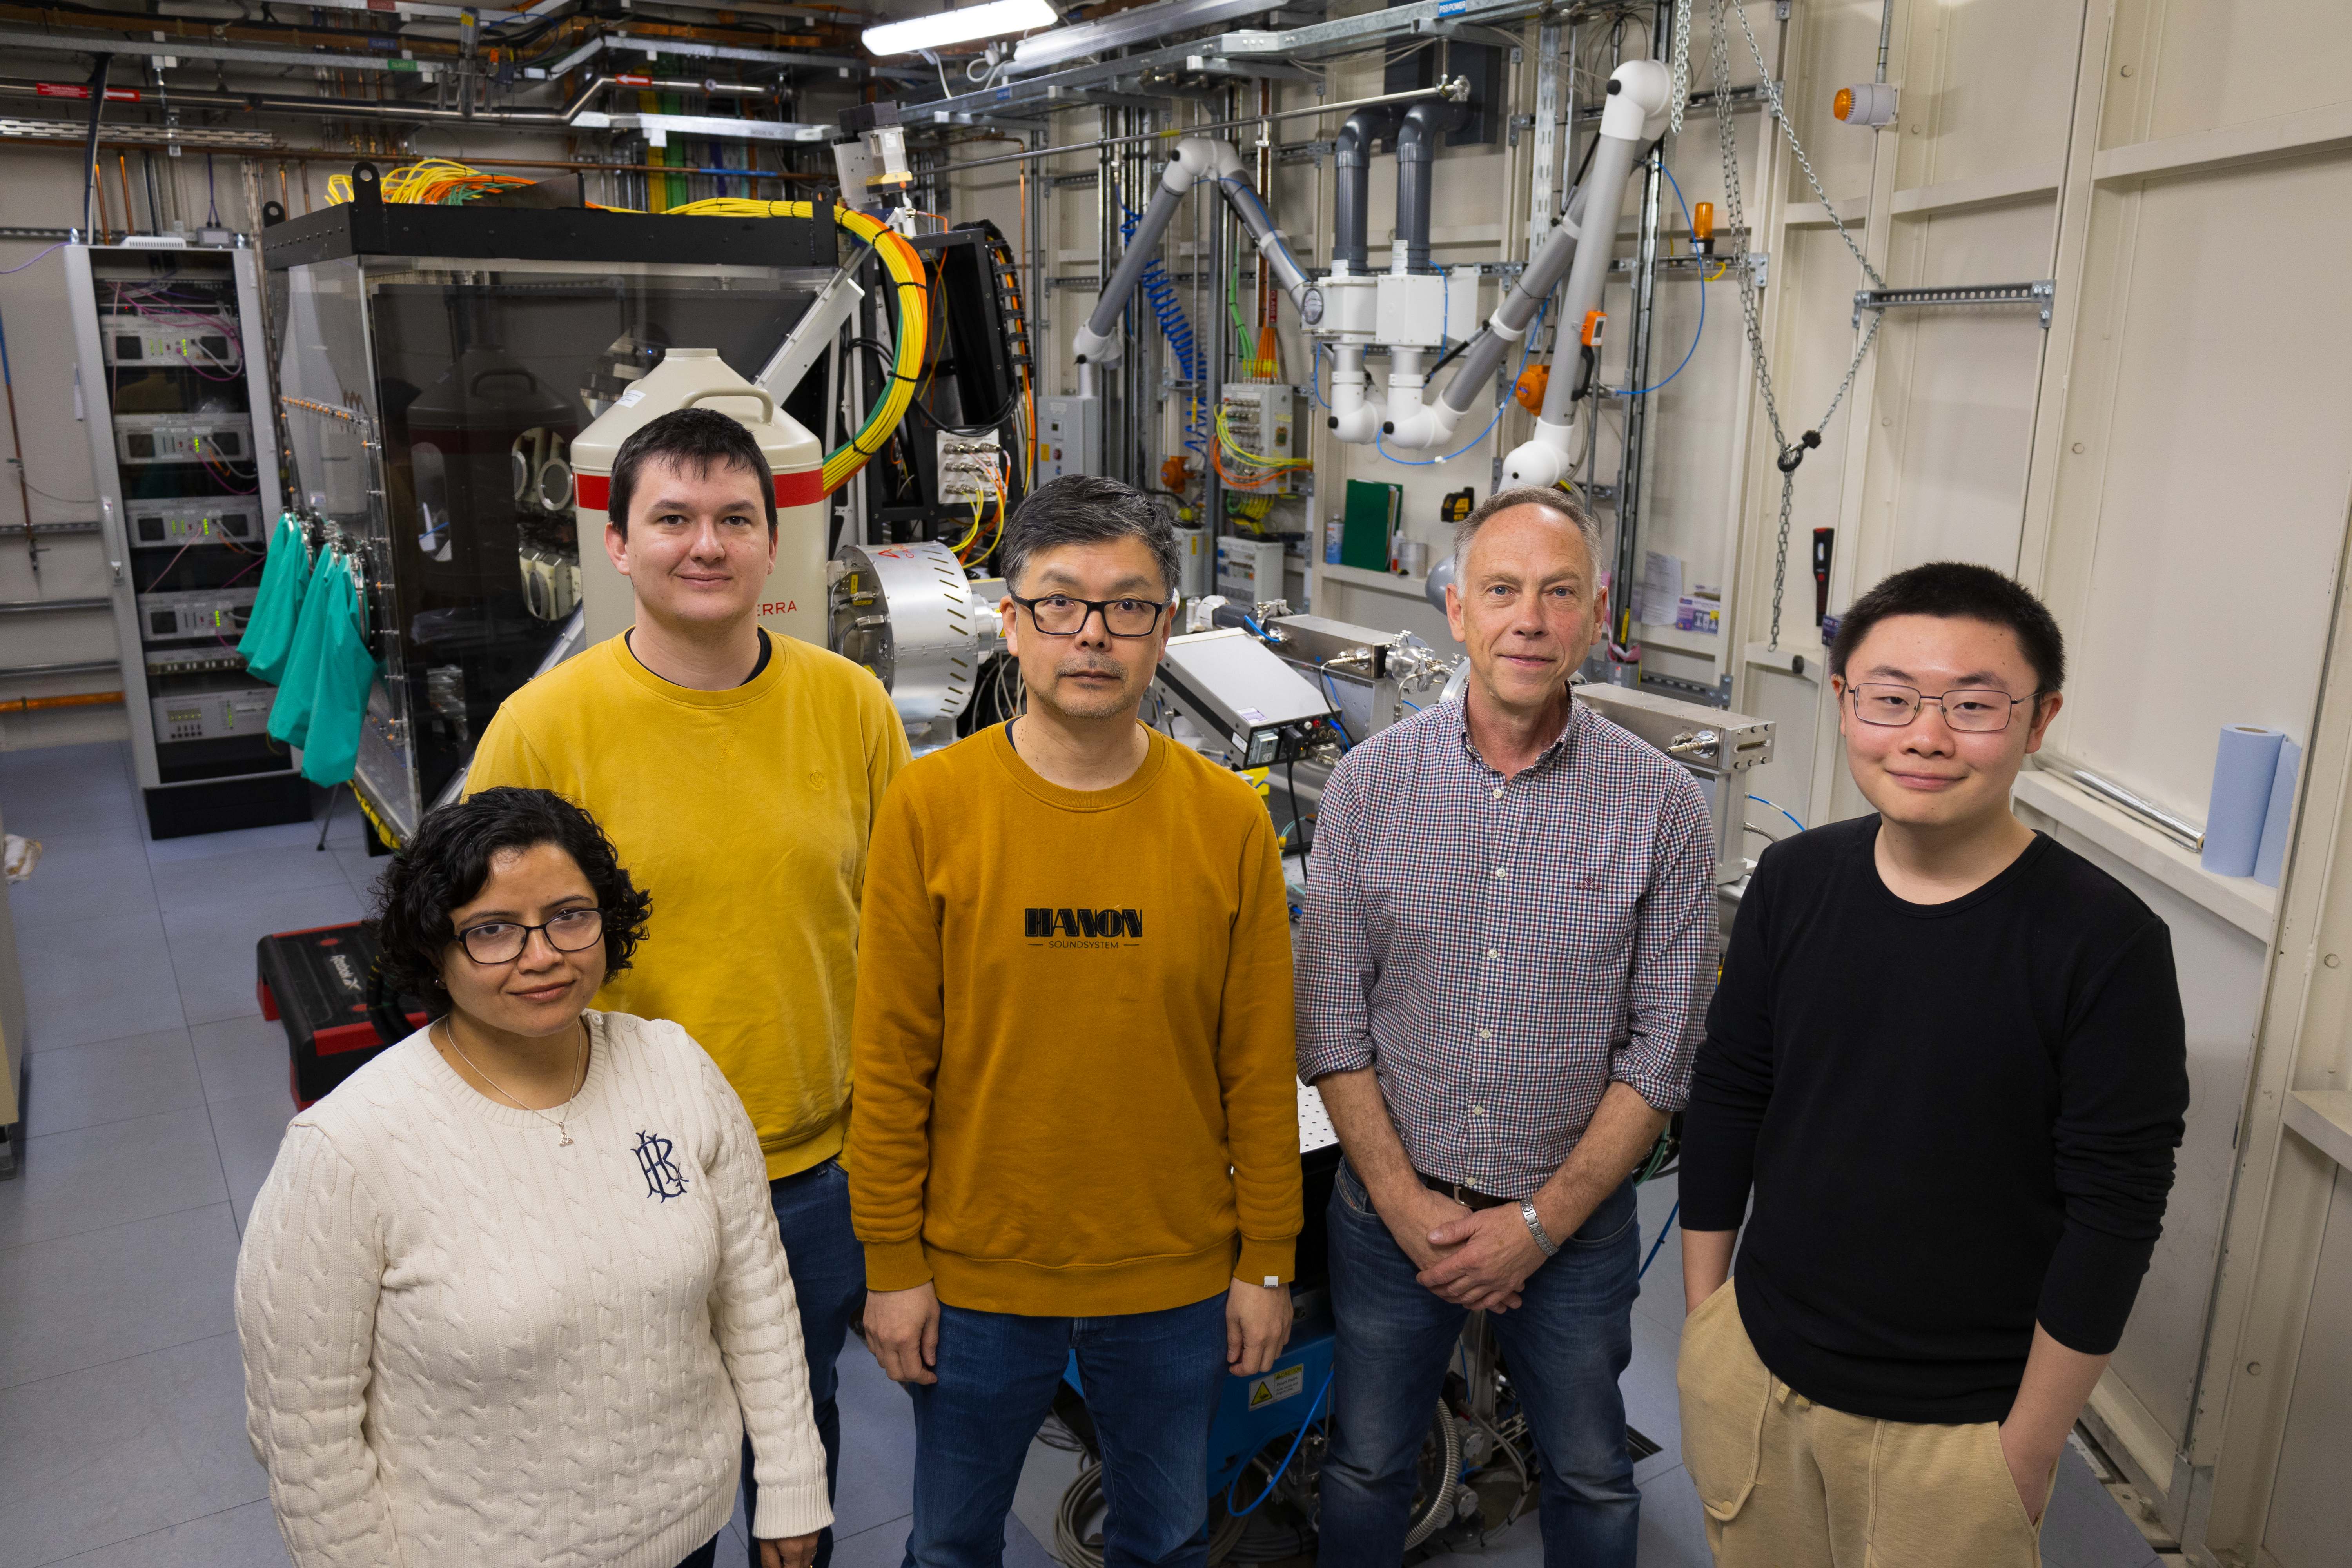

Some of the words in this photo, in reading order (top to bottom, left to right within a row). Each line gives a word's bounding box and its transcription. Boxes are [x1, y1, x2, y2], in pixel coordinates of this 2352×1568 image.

[1024, 908, 1143, 938] HANON
[1049, 940, 1119, 949] SOUNDSYSTEM
[1281, 1366, 1302, 1376] CAUTION
